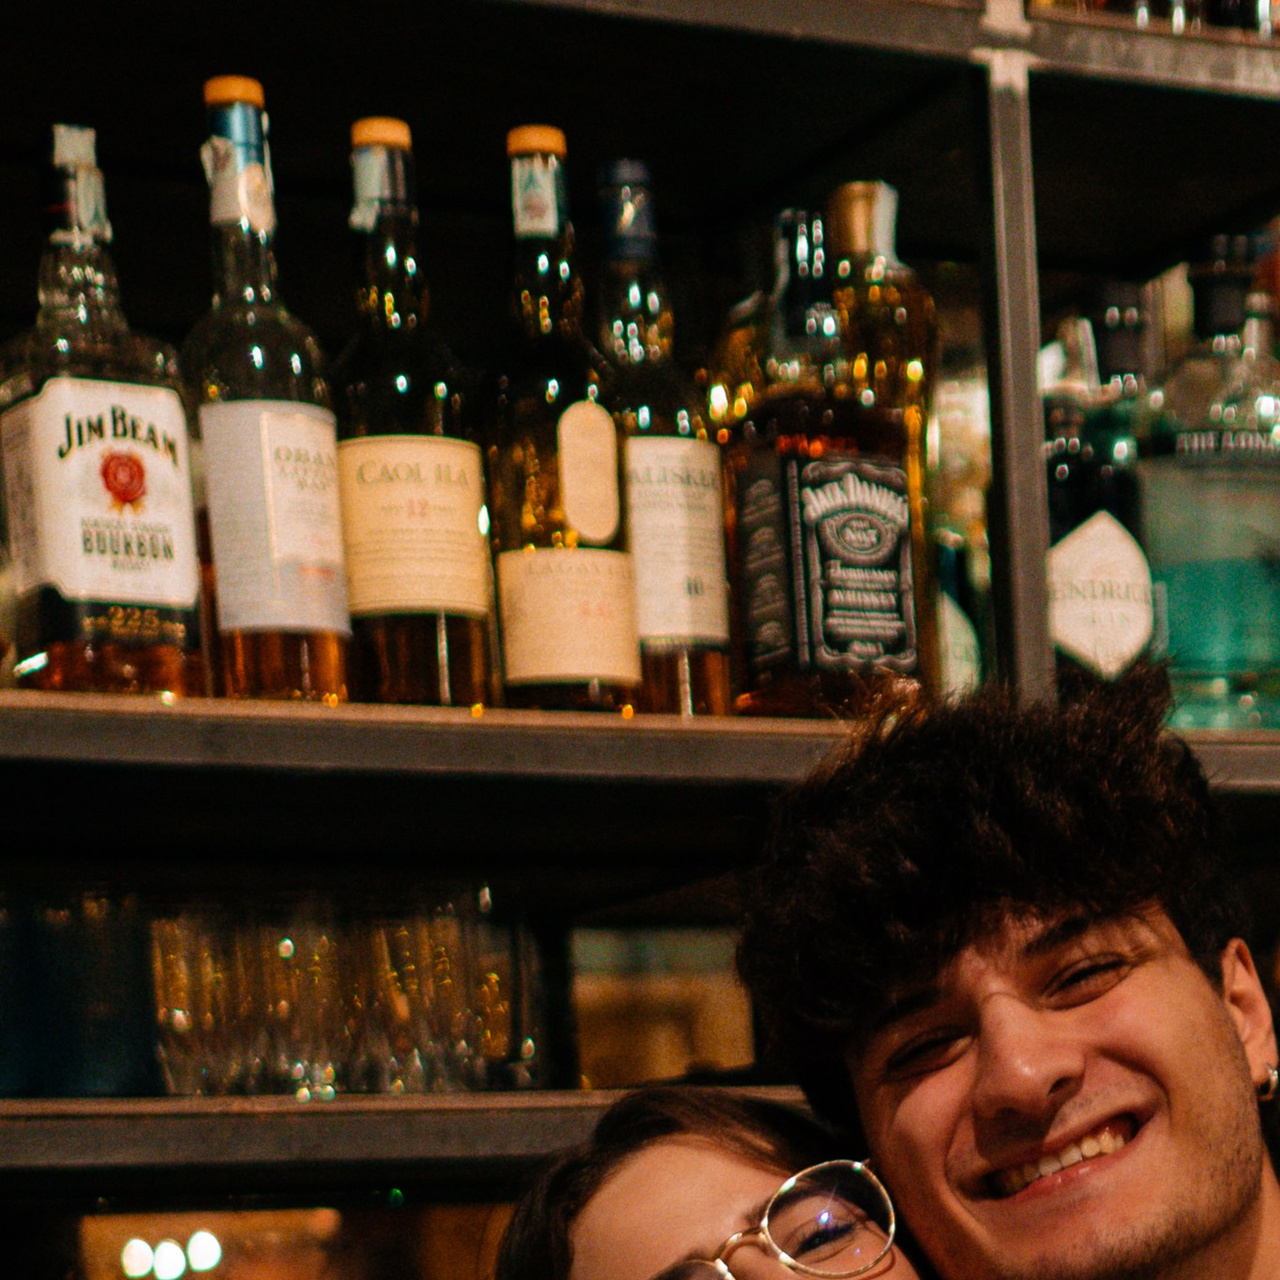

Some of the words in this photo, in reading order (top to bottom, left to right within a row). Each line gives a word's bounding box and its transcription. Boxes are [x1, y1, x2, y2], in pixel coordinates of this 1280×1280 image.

[58, 412, 104, 460] JIM
[111, 404, 178, 468] BEAM
[356, 460, 426, 485] CAOL
[82, 532, 174, 560] BOURBON
